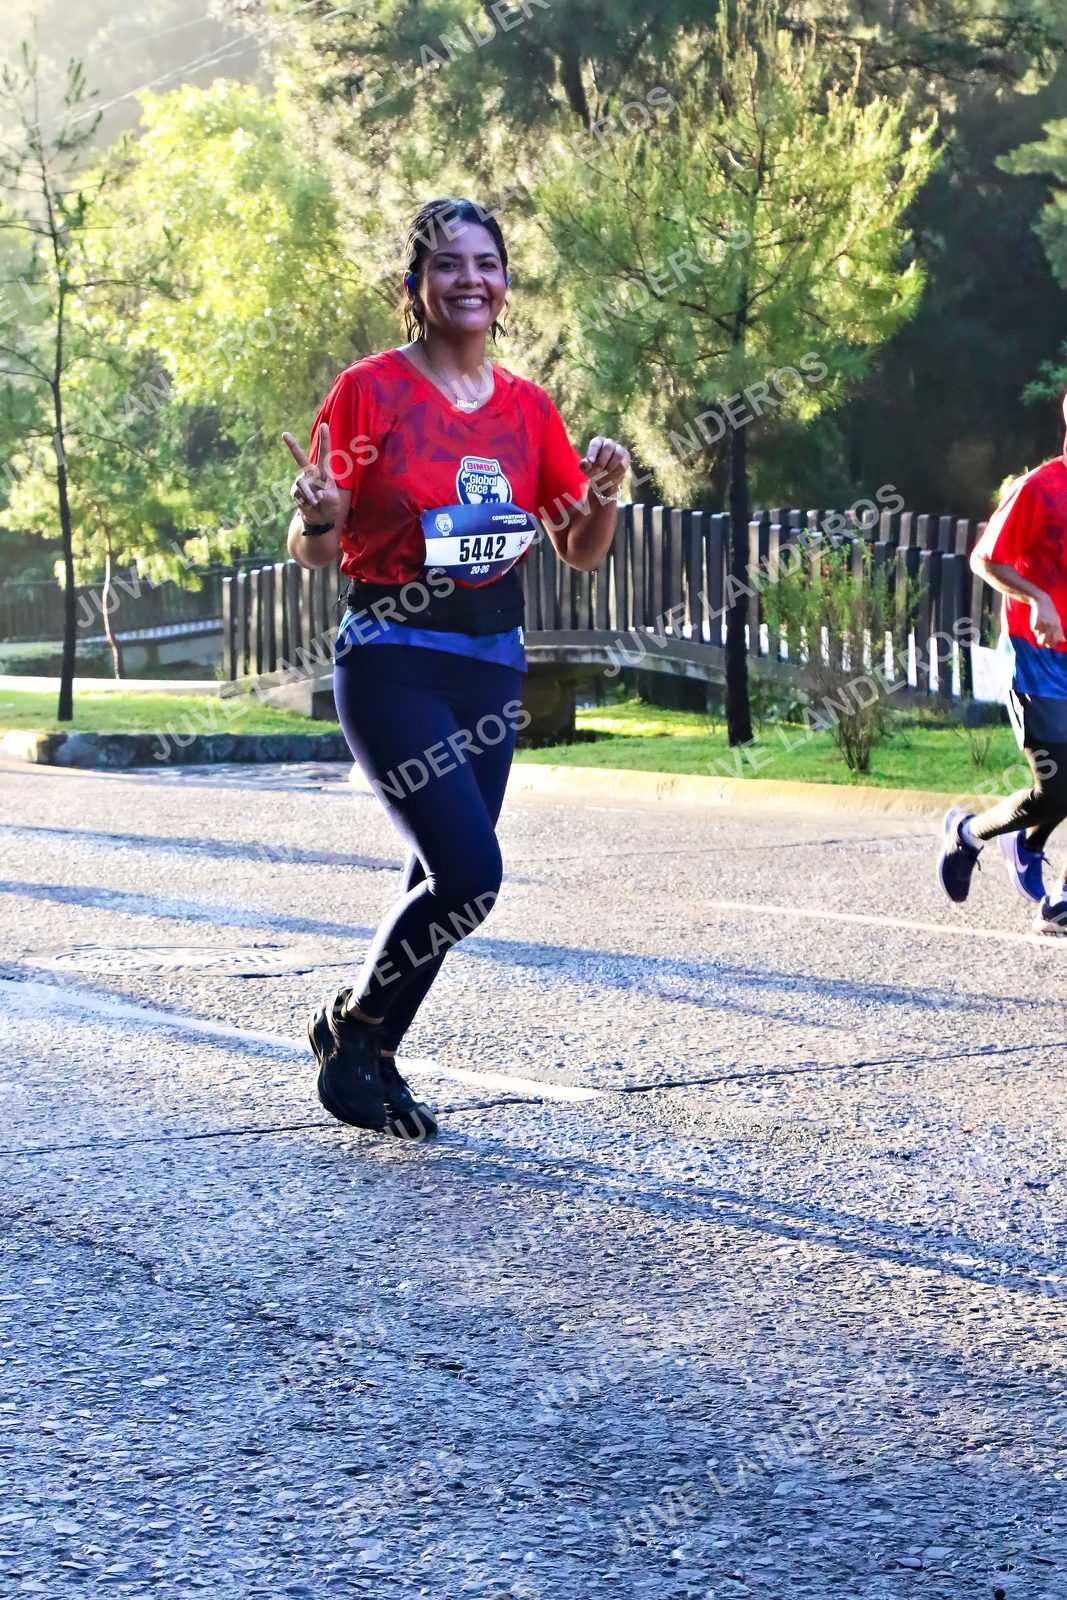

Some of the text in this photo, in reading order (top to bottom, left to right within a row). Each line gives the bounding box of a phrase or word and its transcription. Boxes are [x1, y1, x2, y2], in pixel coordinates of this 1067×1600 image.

[467, 462, 496, 473] BIMBO
[469, 474, 498, 487] Global
[465, 482, 489, 494] Race
[460, 536, 506, 562] 5442
